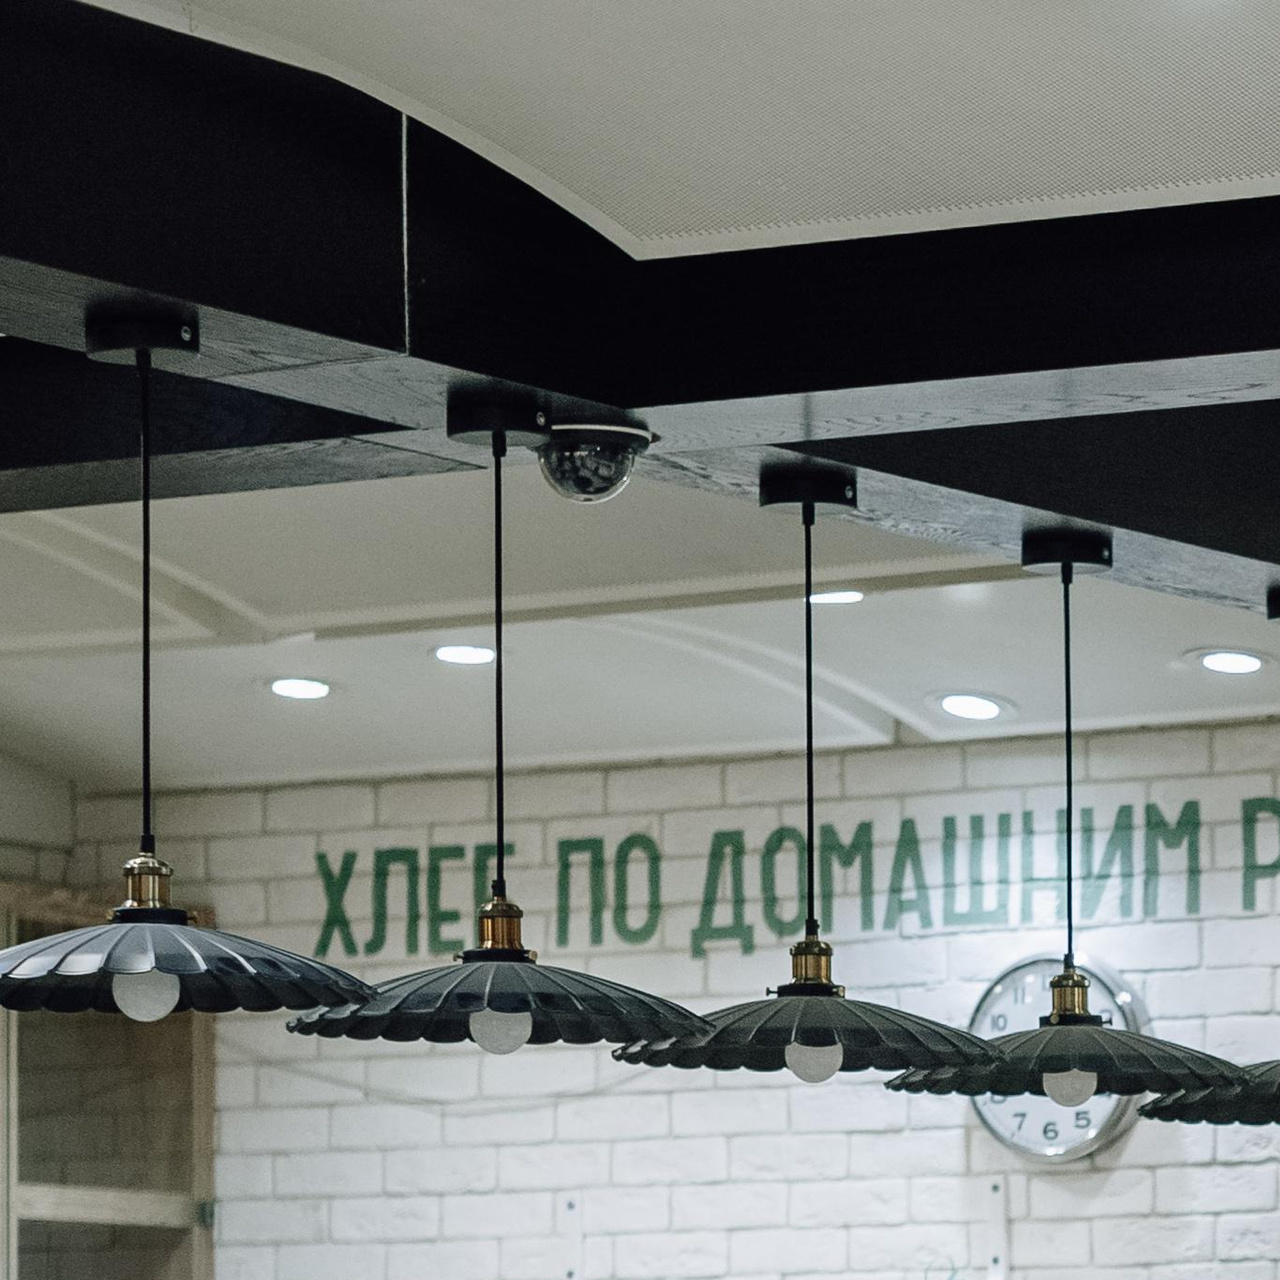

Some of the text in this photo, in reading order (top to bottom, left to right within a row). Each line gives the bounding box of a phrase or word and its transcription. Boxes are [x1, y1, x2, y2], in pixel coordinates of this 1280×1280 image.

[556, 832, 661, 948] ПО
[690, 800, 1201, 960] ДОМАШНИМ
[990, 1014, 1008, 1031] 10
[1012, 1113, 1027, 1131] 7
[1074, 1110, 1091, 1129] 5
[1042, 1121, 1059, 1141] 6
